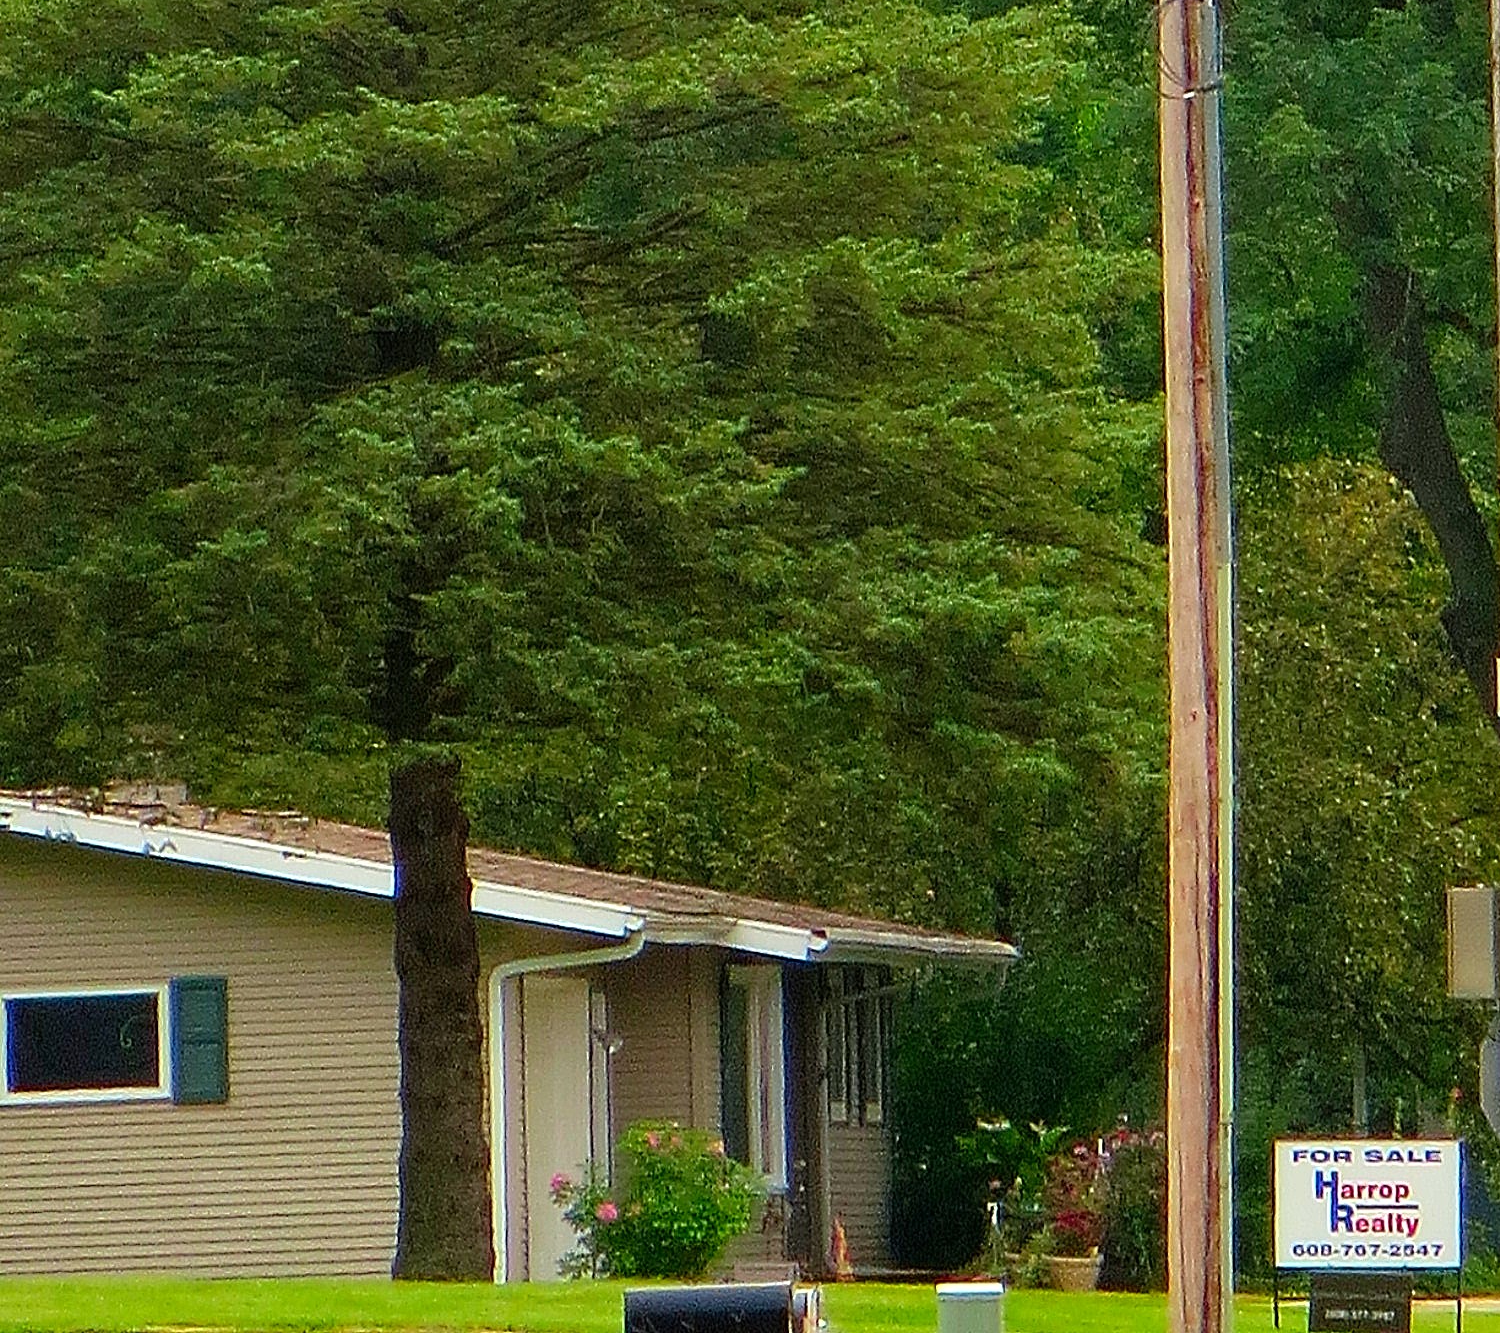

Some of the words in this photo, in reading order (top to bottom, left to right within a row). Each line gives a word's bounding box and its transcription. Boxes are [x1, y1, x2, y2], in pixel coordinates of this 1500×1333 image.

[1292, 1150, 1352, 1163] FOR
[1364, 1150, 1442, 1163] SALE
[1315, 1170, 1409, 1202] Harrop
[1331, 1204, 1419, 1237] Realty
